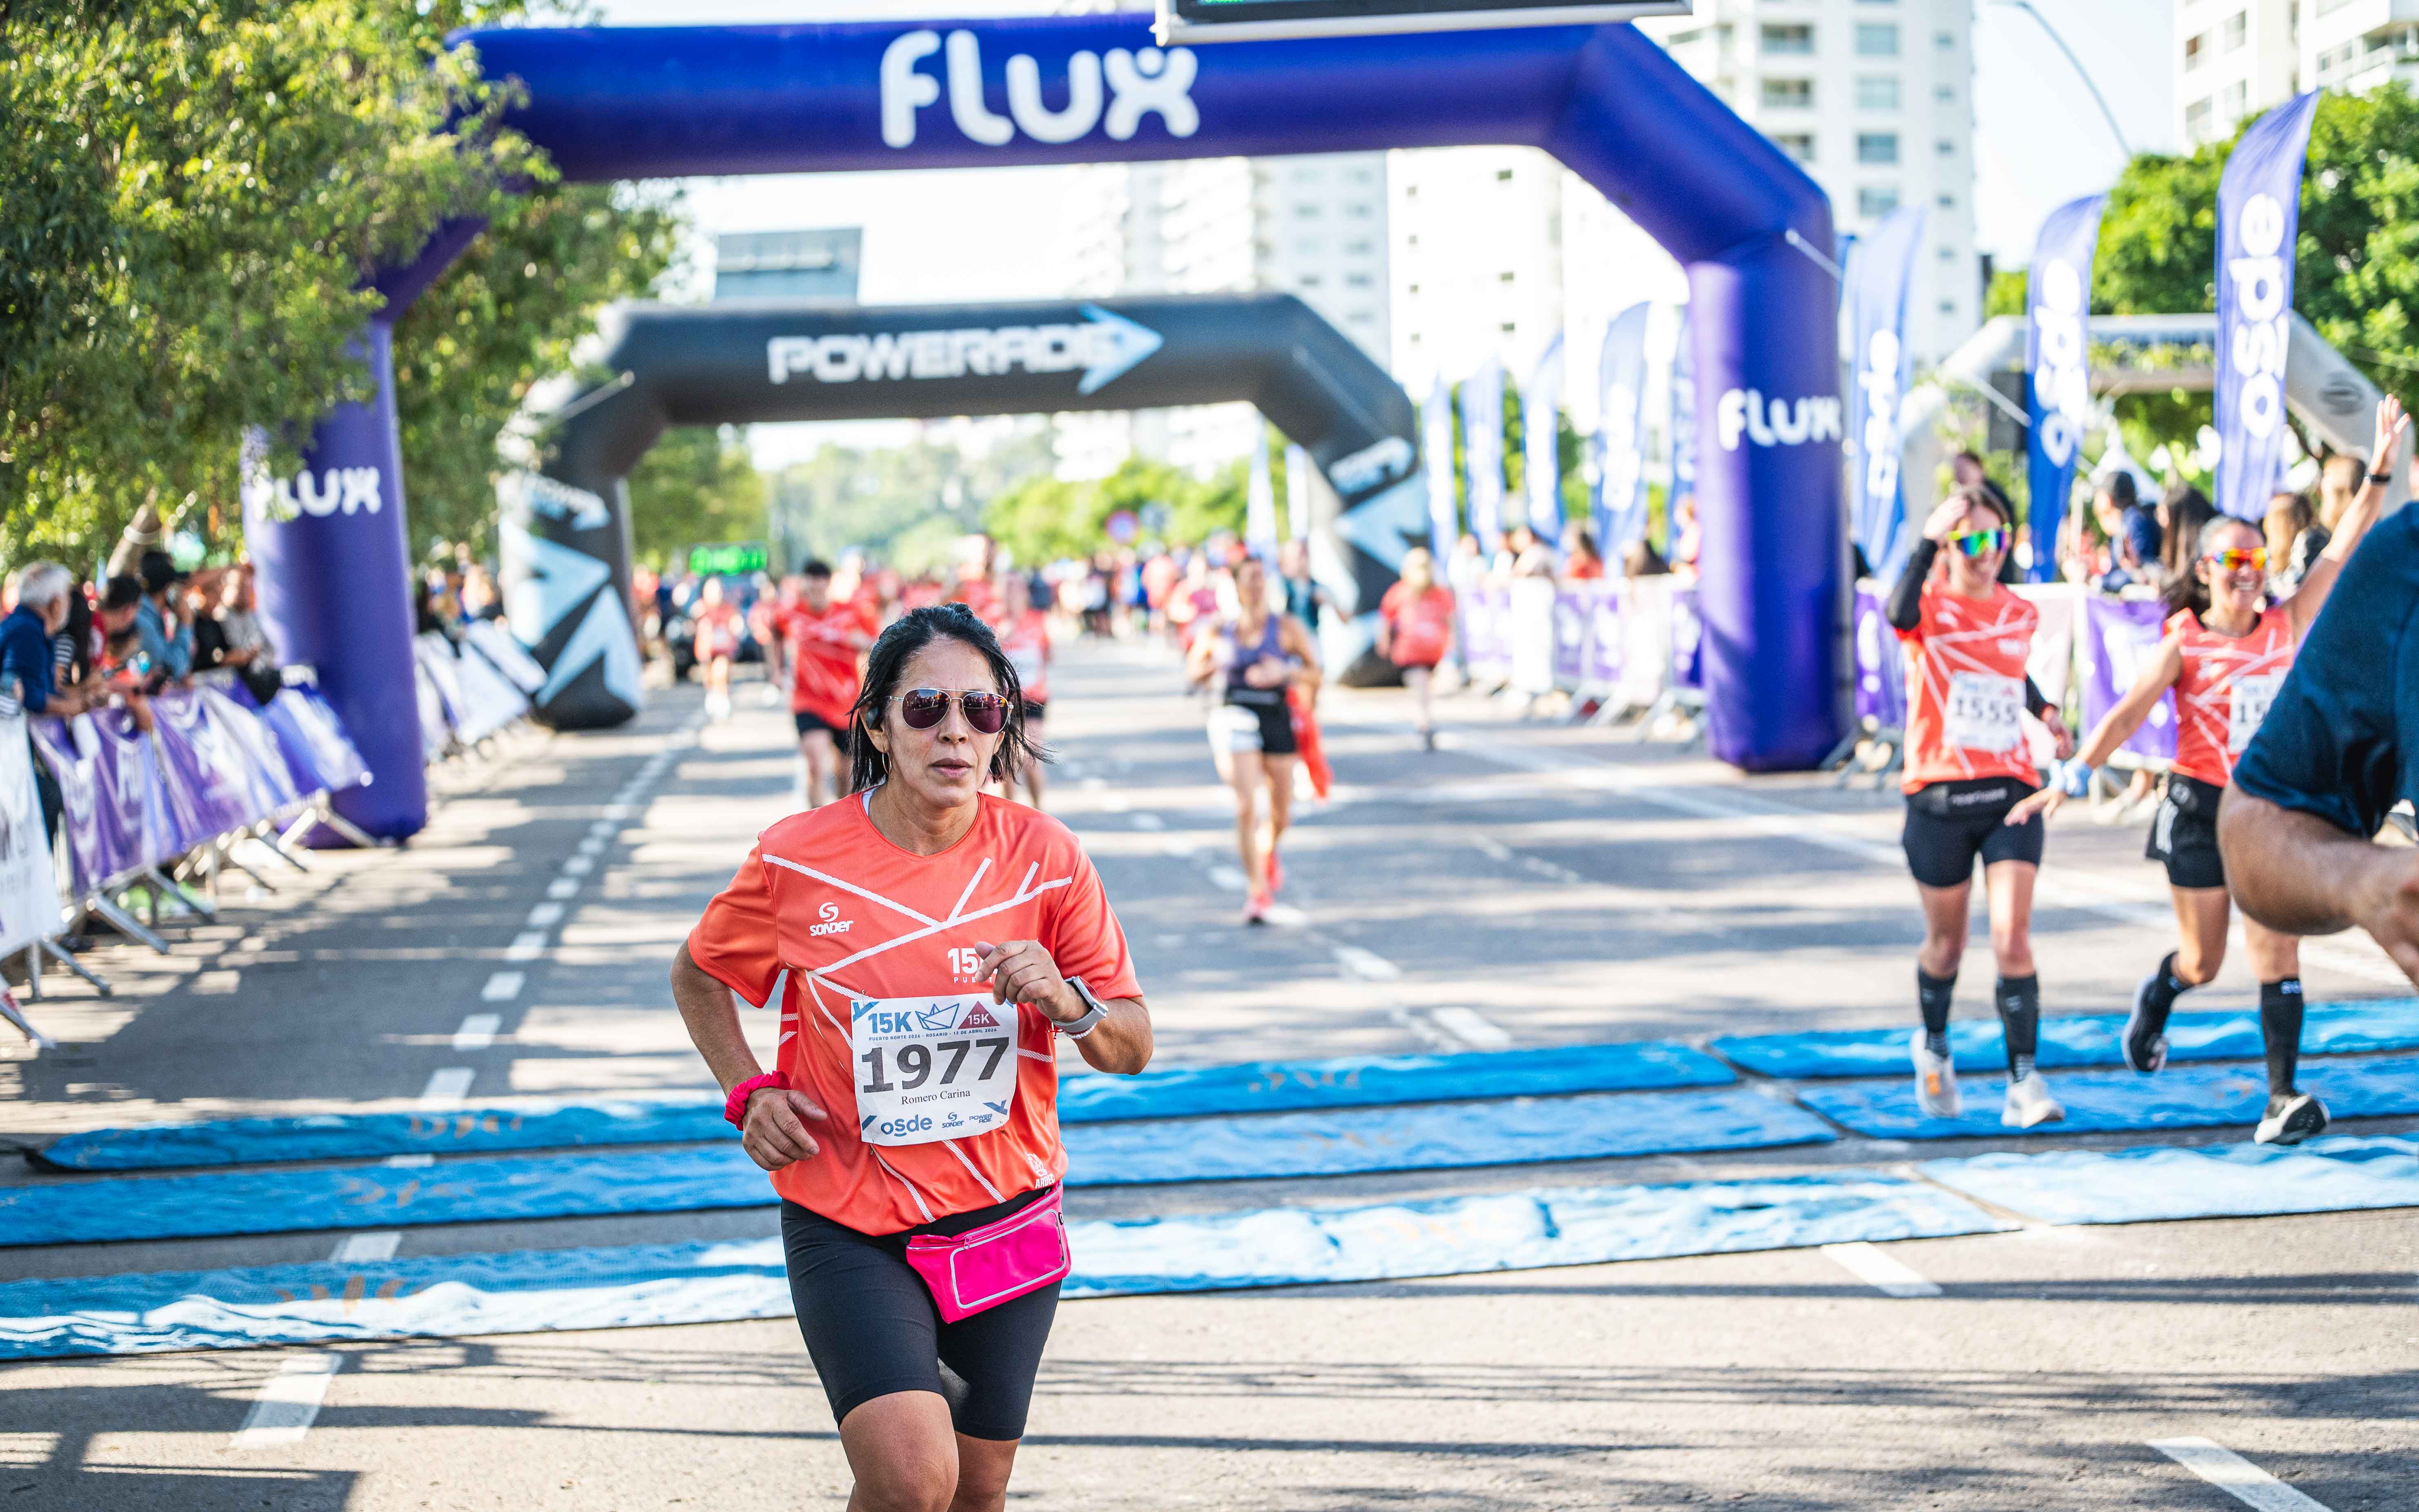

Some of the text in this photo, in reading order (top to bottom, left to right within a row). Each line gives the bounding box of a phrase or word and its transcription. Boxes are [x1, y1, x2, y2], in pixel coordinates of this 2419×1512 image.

[2228, 193, 2290, 439] osde
[1955, 696, 2017, 726] 1555
[947, 947, 998, 974] 15
[869, 1012, 913, 1034] 15K
[968, 1013, 990, 1025] 15K
[862, 1037, 1010, 1093] 1977
[901, 1089, 971, 1105] Romero Carina
[881, 1114, 932, 1137] osde
